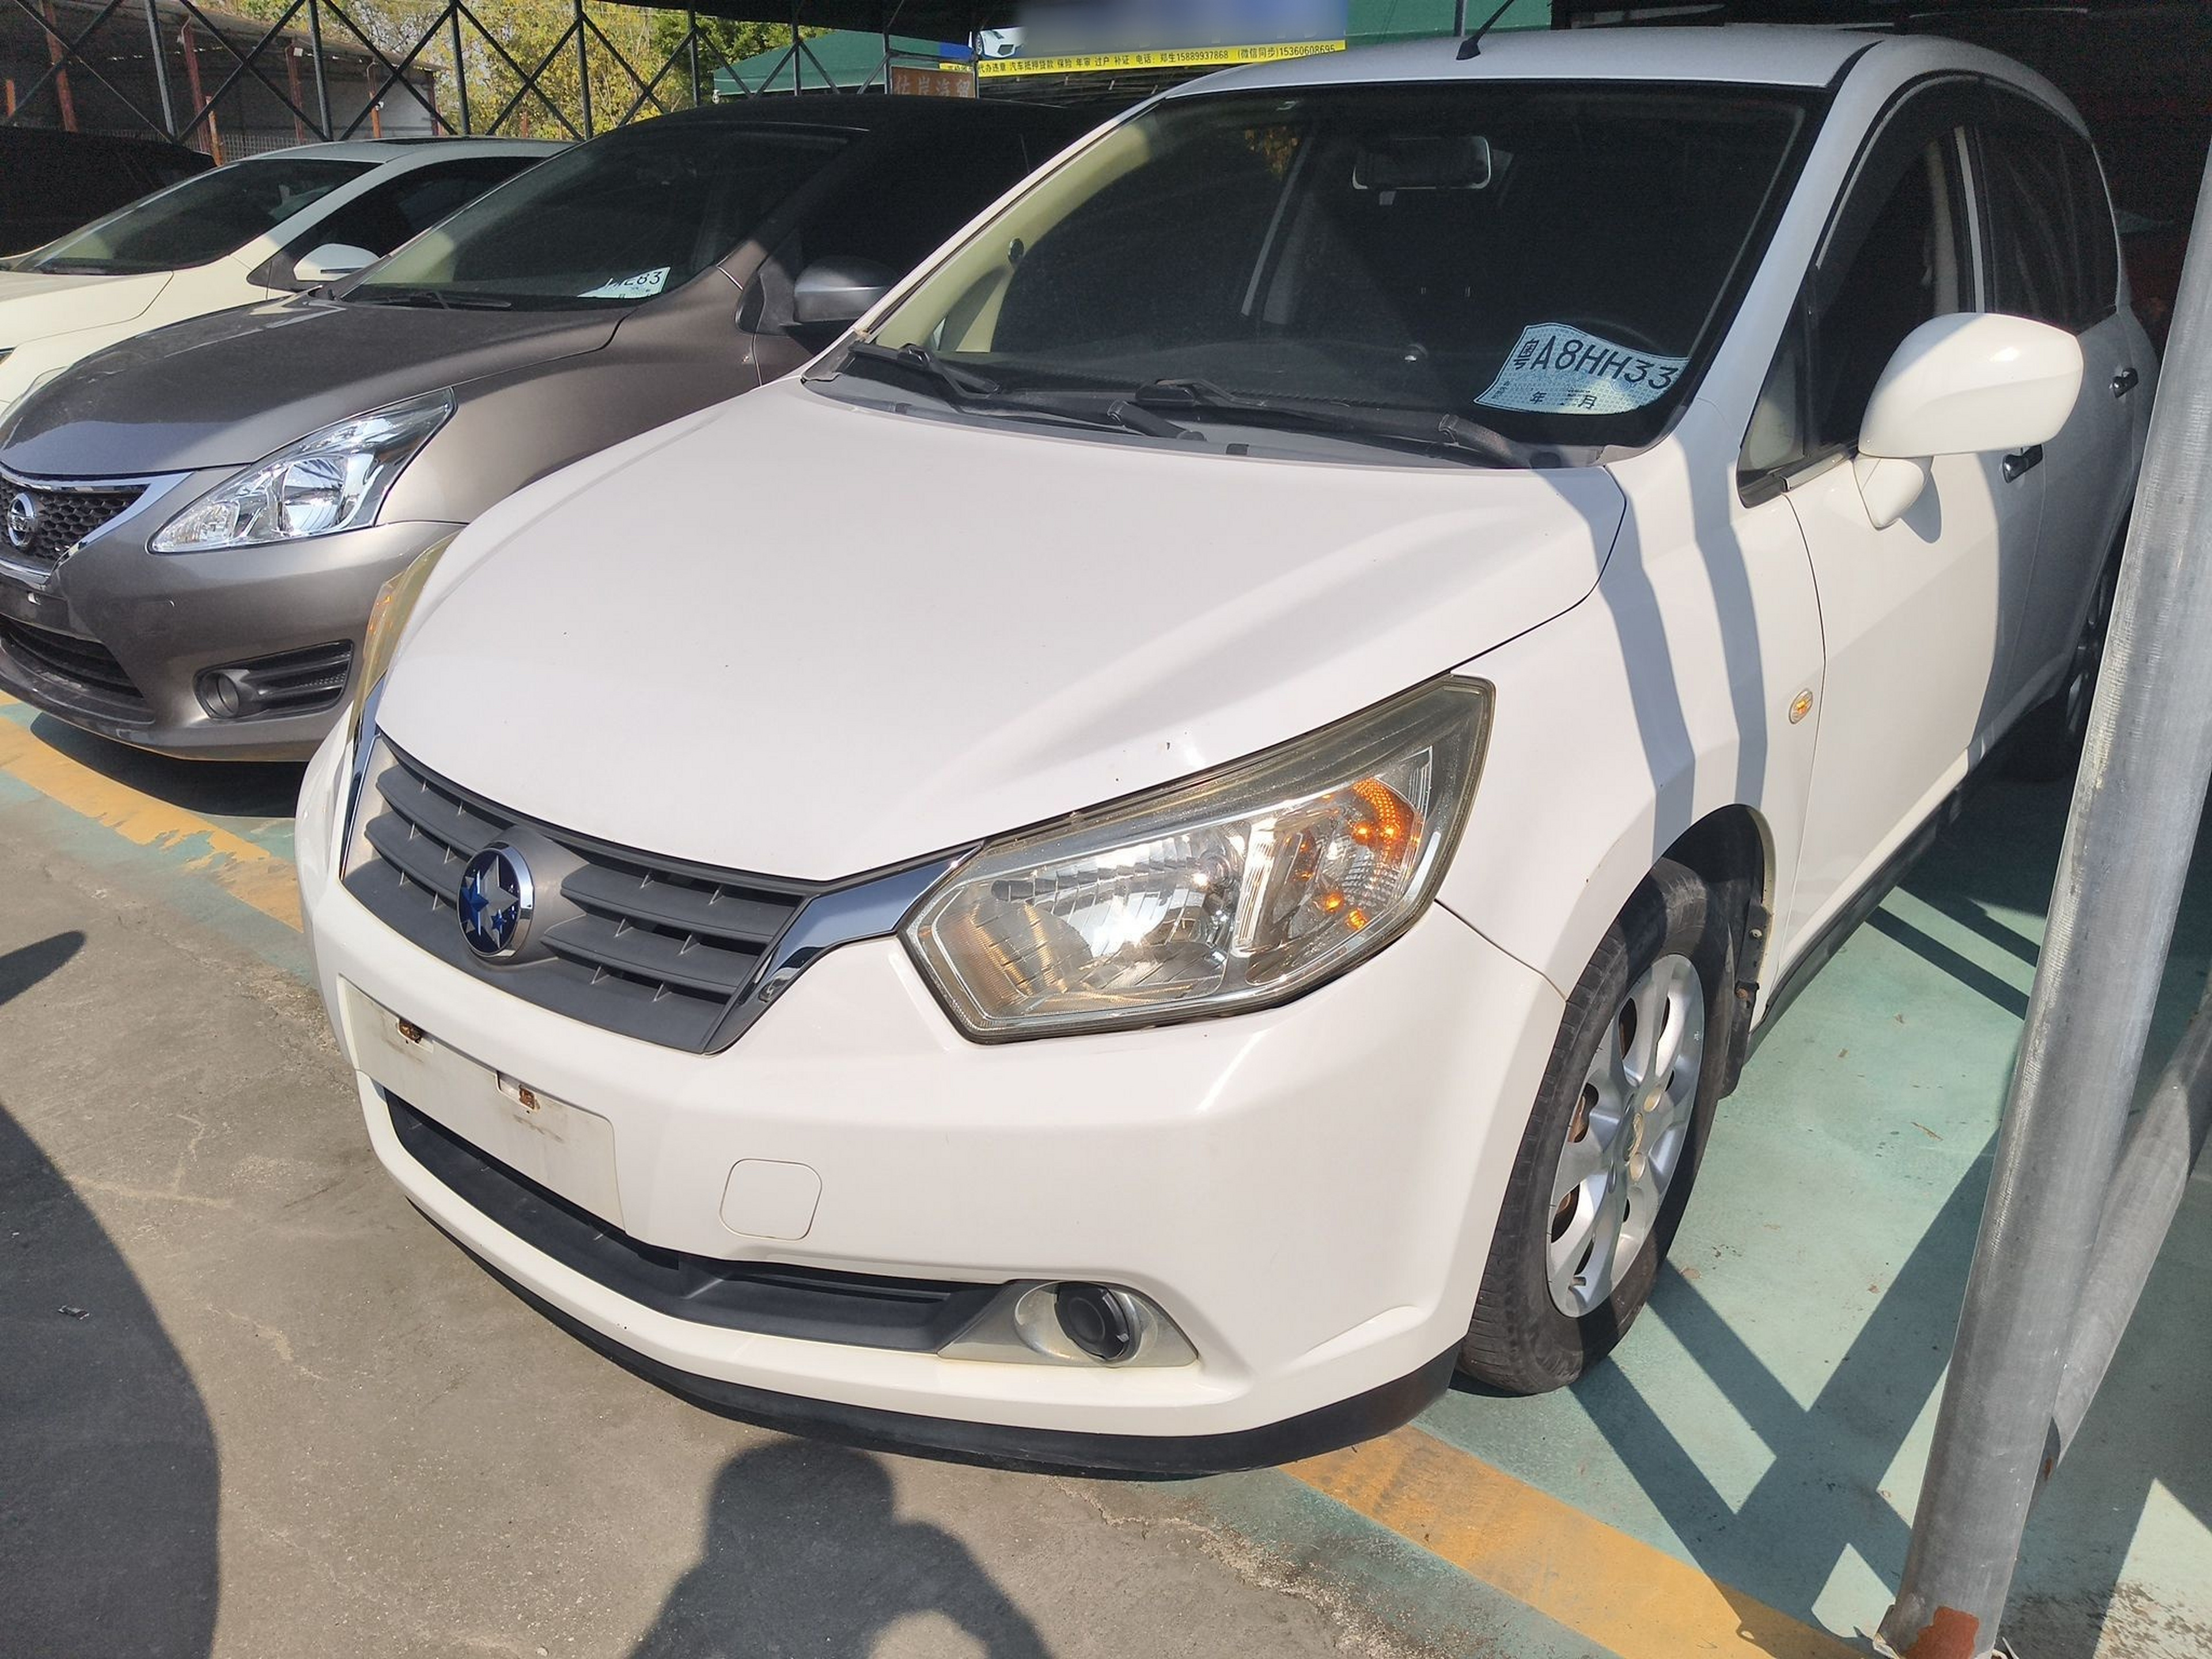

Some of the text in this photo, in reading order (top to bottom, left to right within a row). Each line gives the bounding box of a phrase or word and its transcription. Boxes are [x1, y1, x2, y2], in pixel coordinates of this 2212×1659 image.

[1057, 58, 1072, 68] 保险
[1076, 58, 1090, 67] 年审
[1094, 56, 1109, 66] 过户
[1513, 335, 1679, 389] 粤A8HH33
[1529, 391, 1597, 410] 年 月
